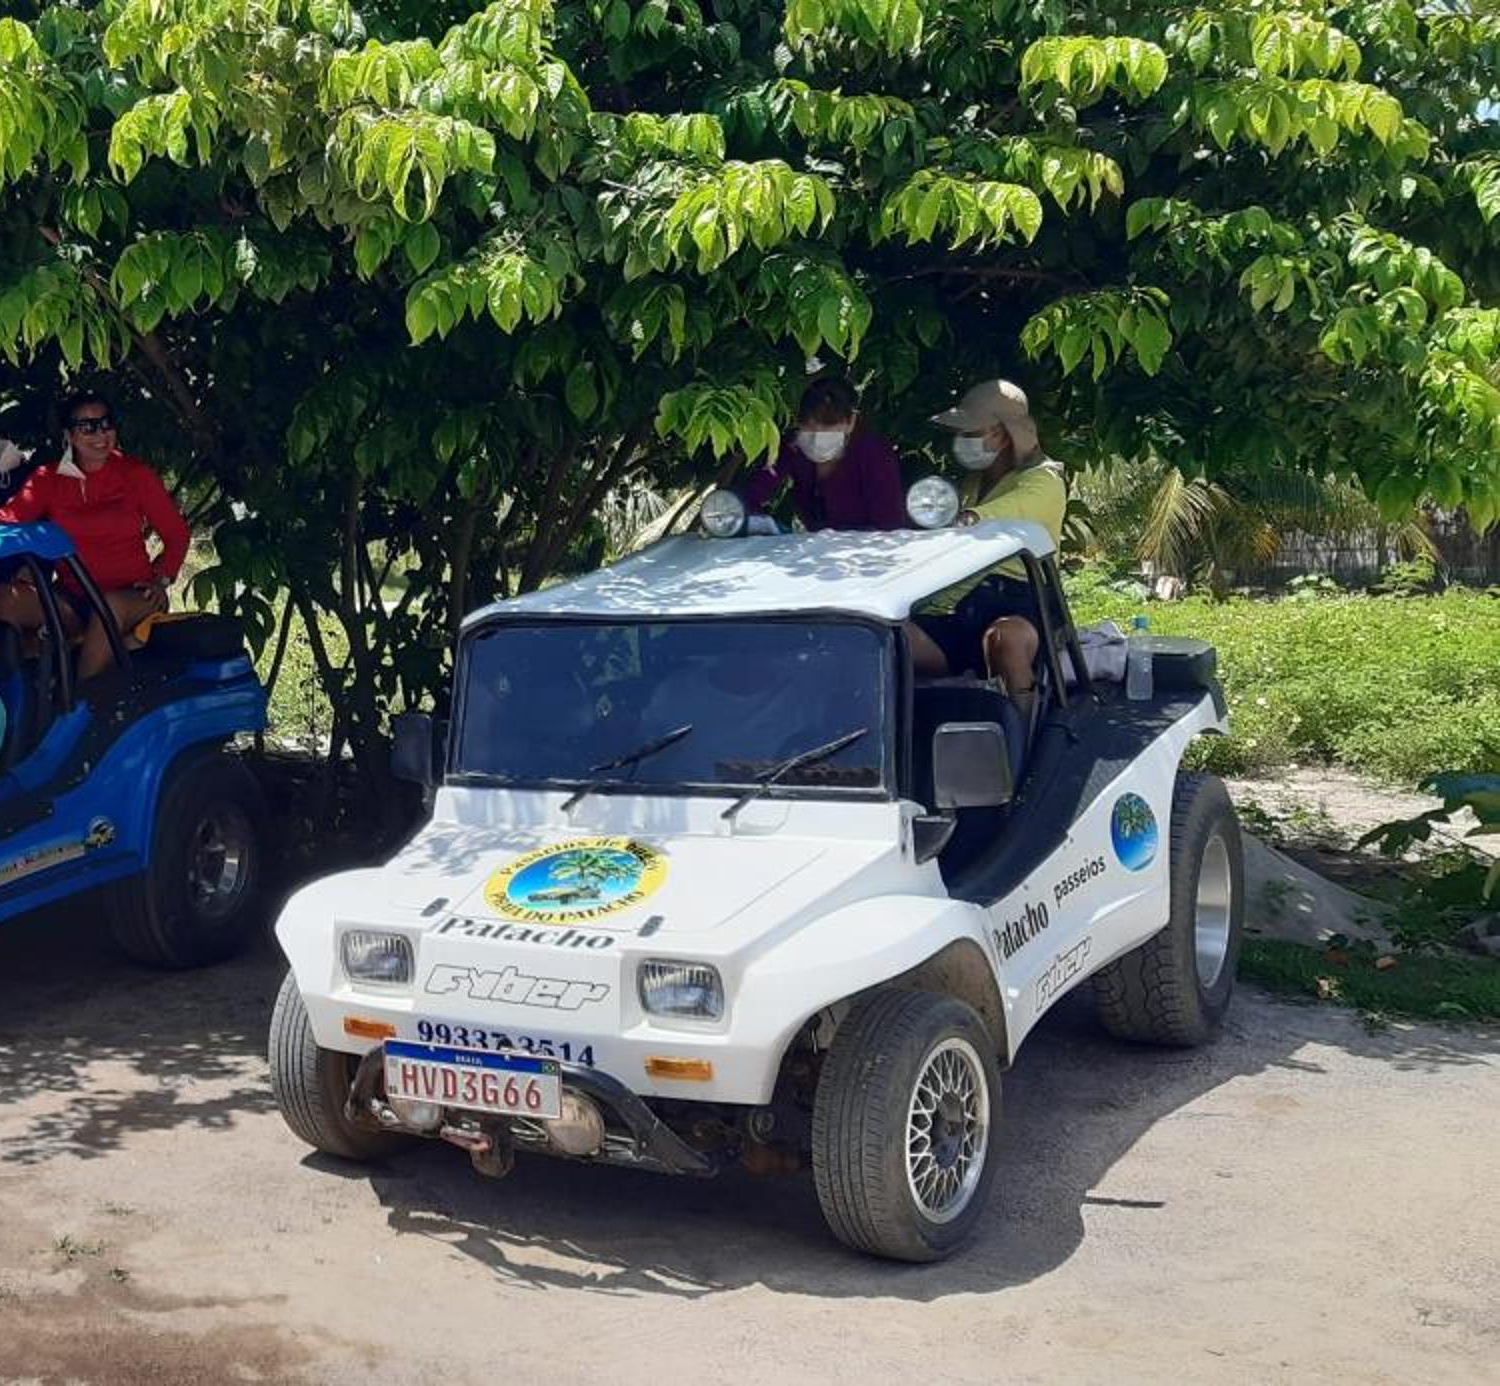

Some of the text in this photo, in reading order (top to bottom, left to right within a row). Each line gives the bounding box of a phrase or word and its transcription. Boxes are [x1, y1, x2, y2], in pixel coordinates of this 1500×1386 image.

[1054, 856, 1106, 909] passeios
[438, 917, 615, 949] Patacho
[992, 901, 1049, 962] Patacho
[401, 1063, 542, 1110] HVD3G66
